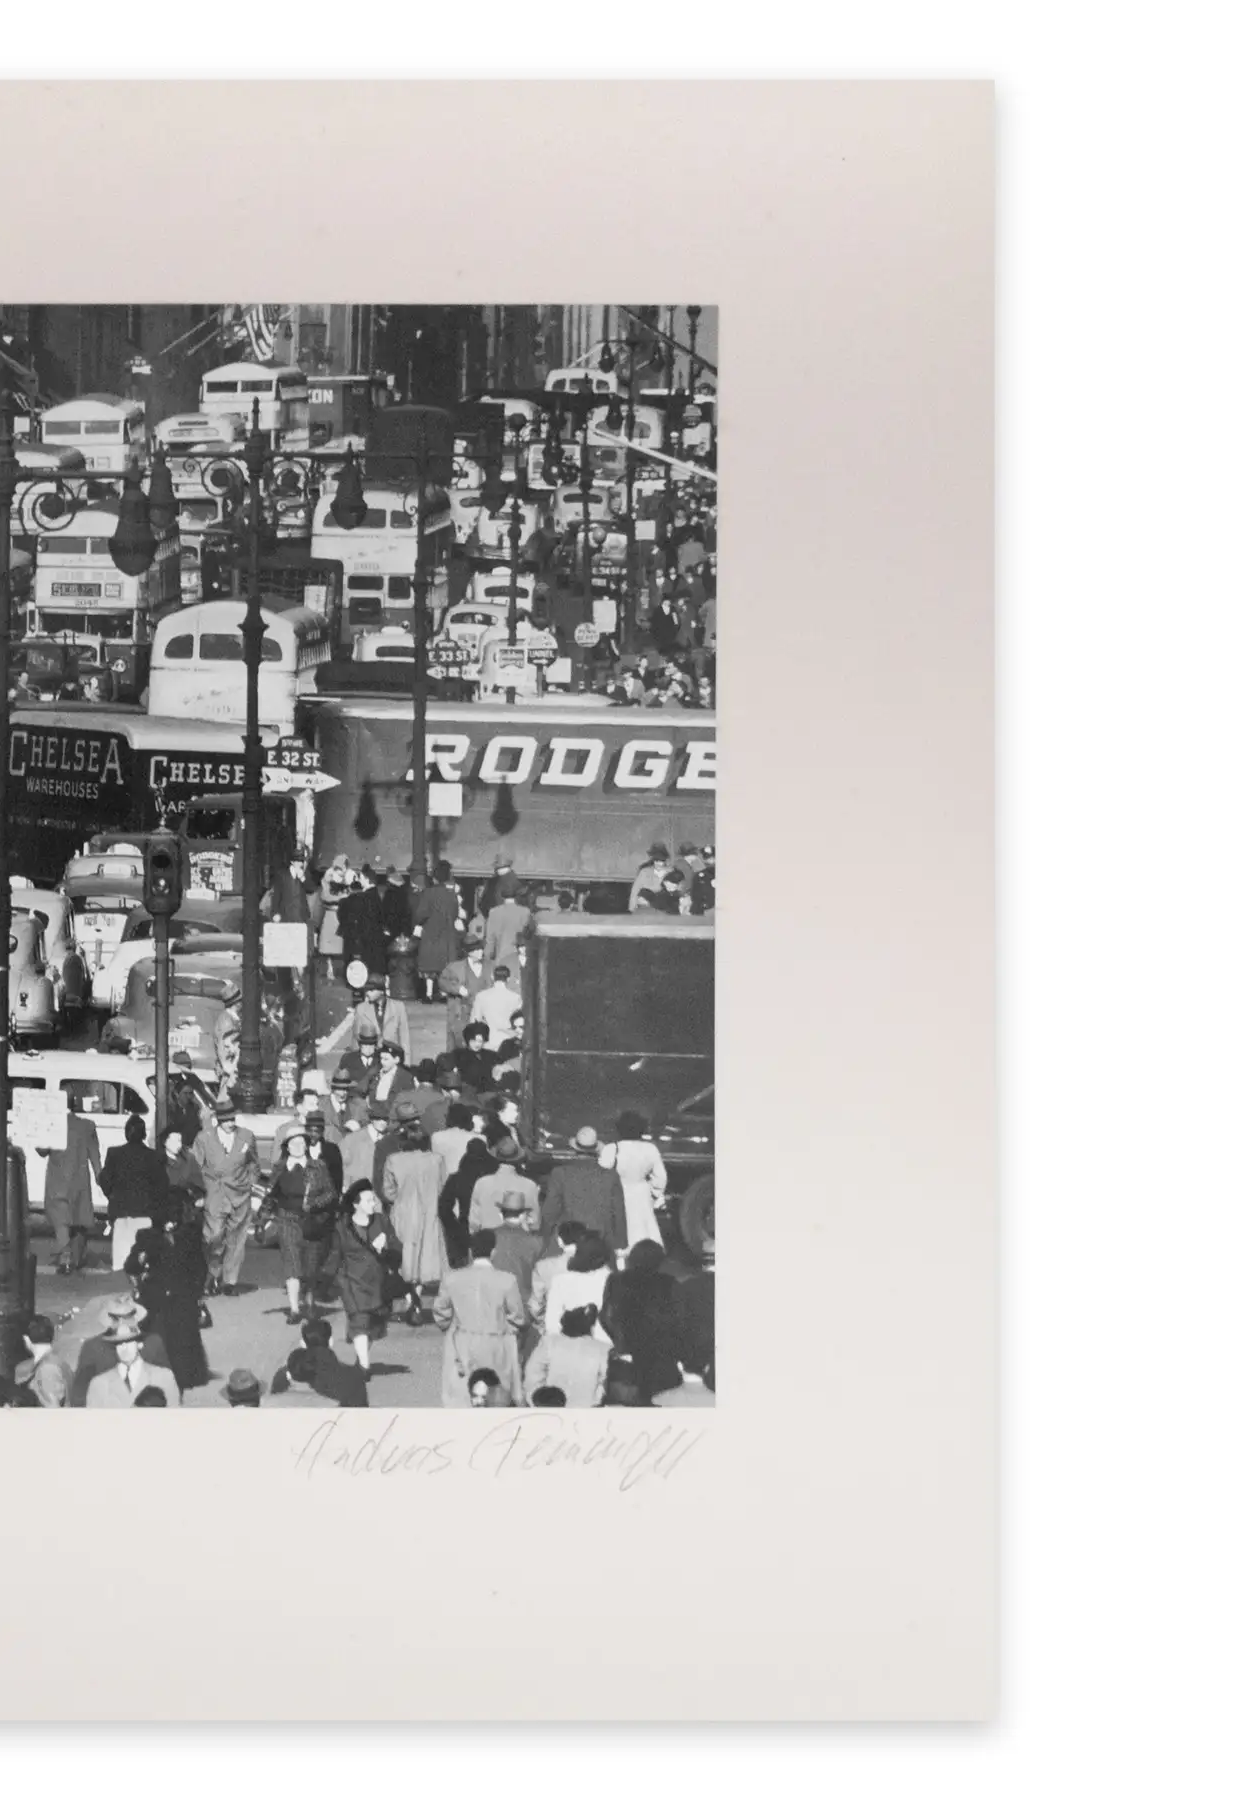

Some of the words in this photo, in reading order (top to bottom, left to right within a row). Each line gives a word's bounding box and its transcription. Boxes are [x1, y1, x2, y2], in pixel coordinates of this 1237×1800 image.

[9, 731, 124, 785] CHELSEA
[282, 751, 300, 766] 32
[149, 756, 247, 789] CHELSE
[26, 776, 99, 799] WAREHOUSES
